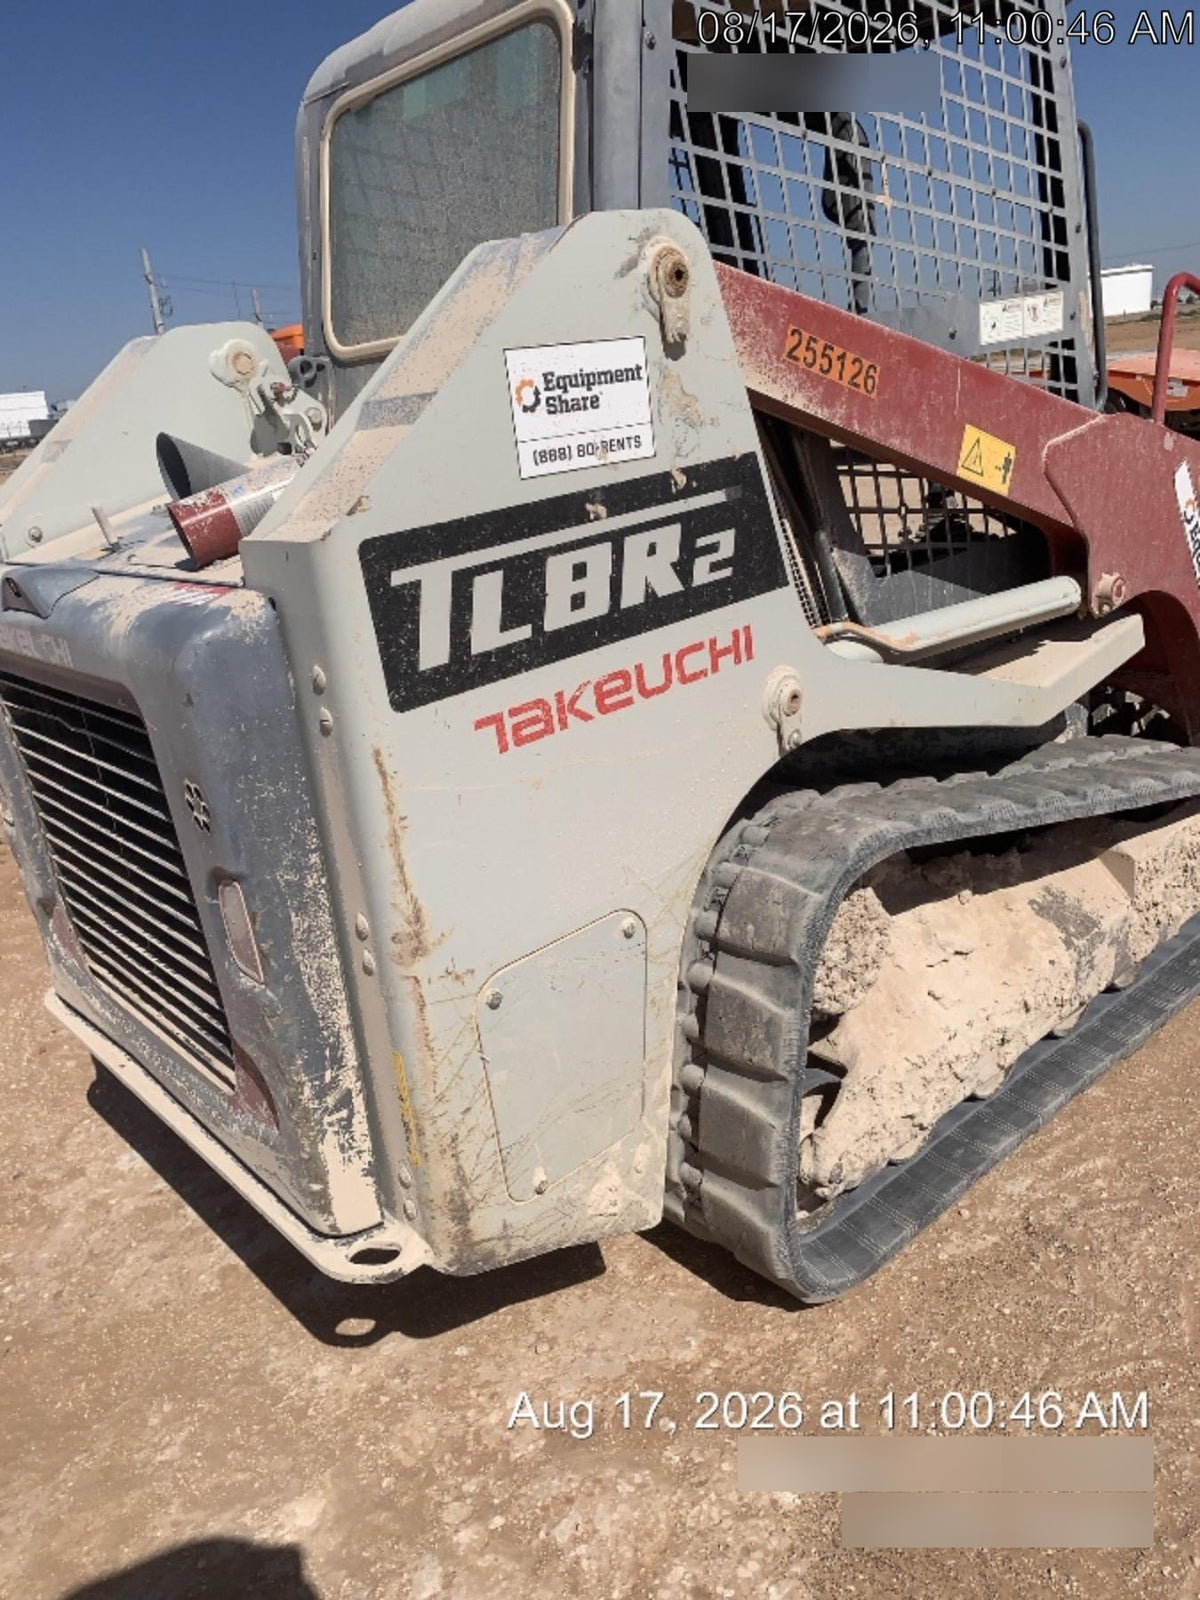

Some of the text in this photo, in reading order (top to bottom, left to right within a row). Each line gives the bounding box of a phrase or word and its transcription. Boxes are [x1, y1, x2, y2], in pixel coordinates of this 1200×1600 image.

[786, 328, 877, 395] 255126
[542, 364, 643, 394] Equipment
[545, 393, 601, 415] Share
[532, 445, 573, 467] (888)
